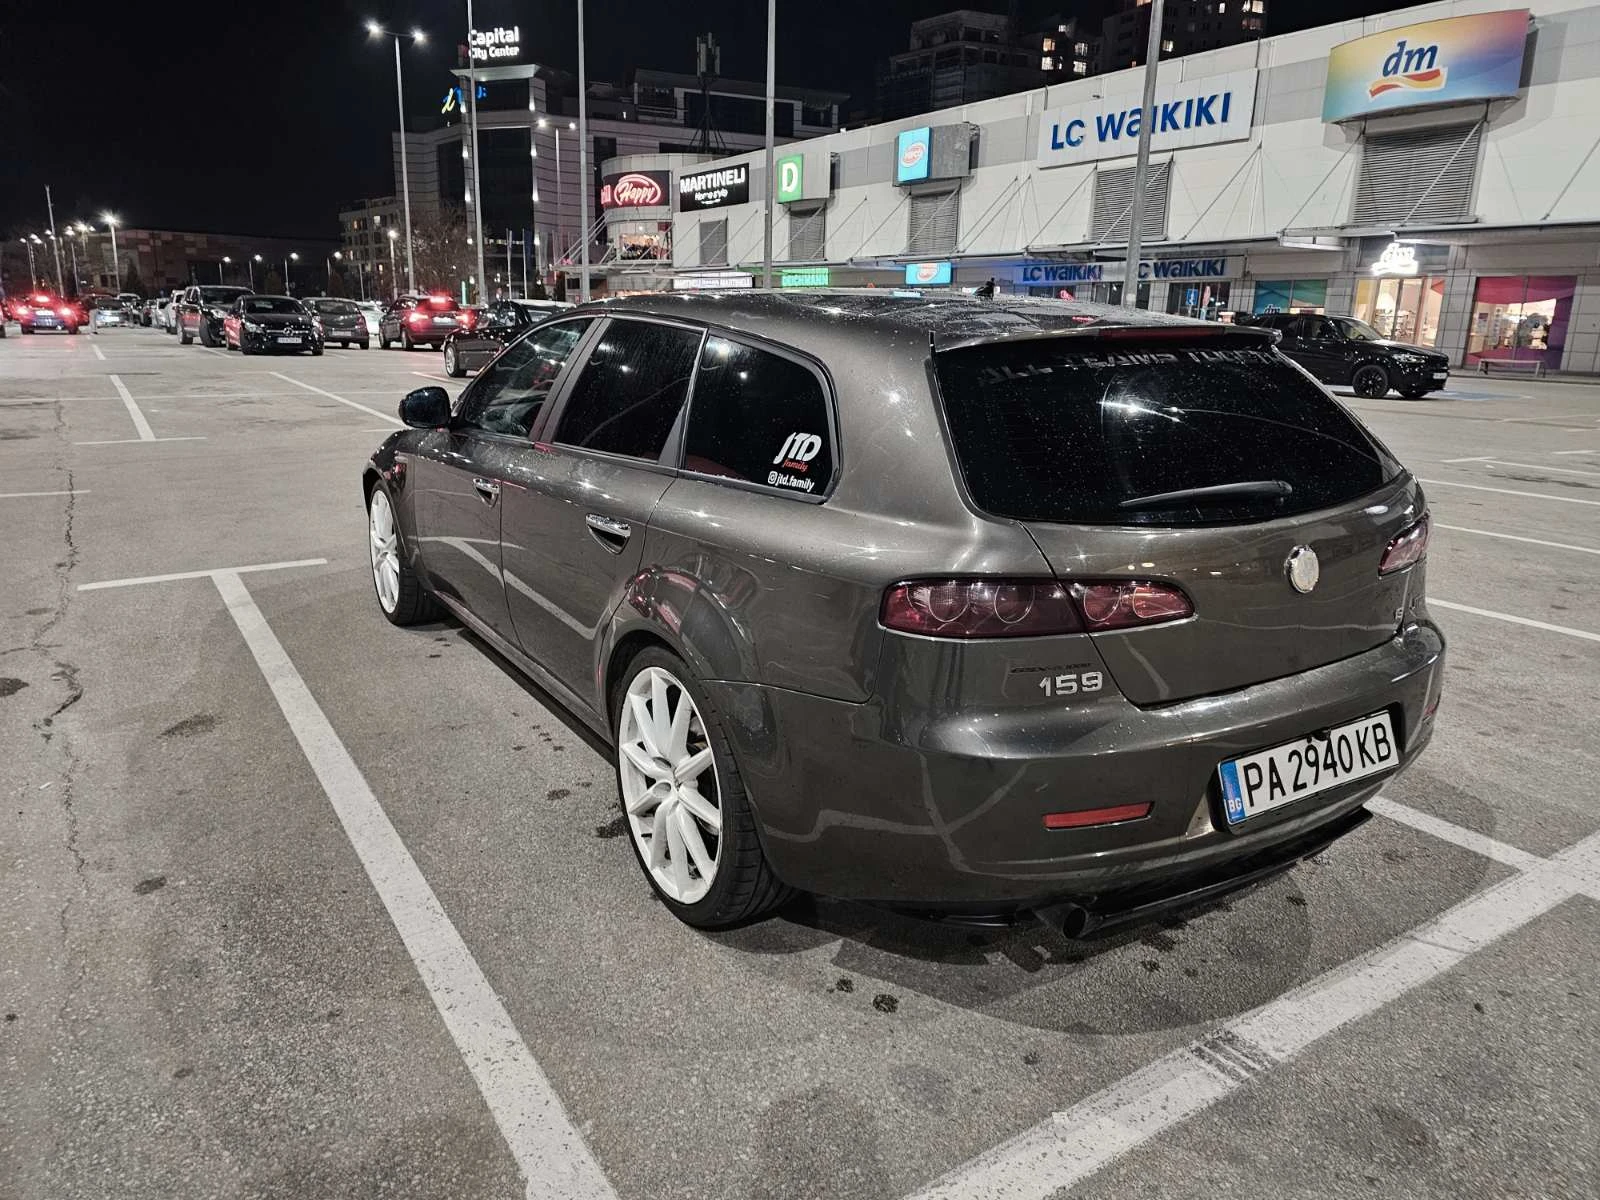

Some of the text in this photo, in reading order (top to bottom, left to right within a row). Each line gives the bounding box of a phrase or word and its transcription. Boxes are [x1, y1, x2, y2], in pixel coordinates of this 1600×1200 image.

[468, 26, 519, 47] Capital
[468, 45, 519, 60] City Center
[1382, 40, 1438, 77] dm
[1051, 119, 1086, 150] LC
[781, 162, 798, 193] D
[618, 182, 655, 204] Happy
[1022, 266, 1042, 282] LC
[773, 432, 822, 465] JTD
[1039, 671, 1103, 697] 159
[1228, 798, 1243, 813] BG
